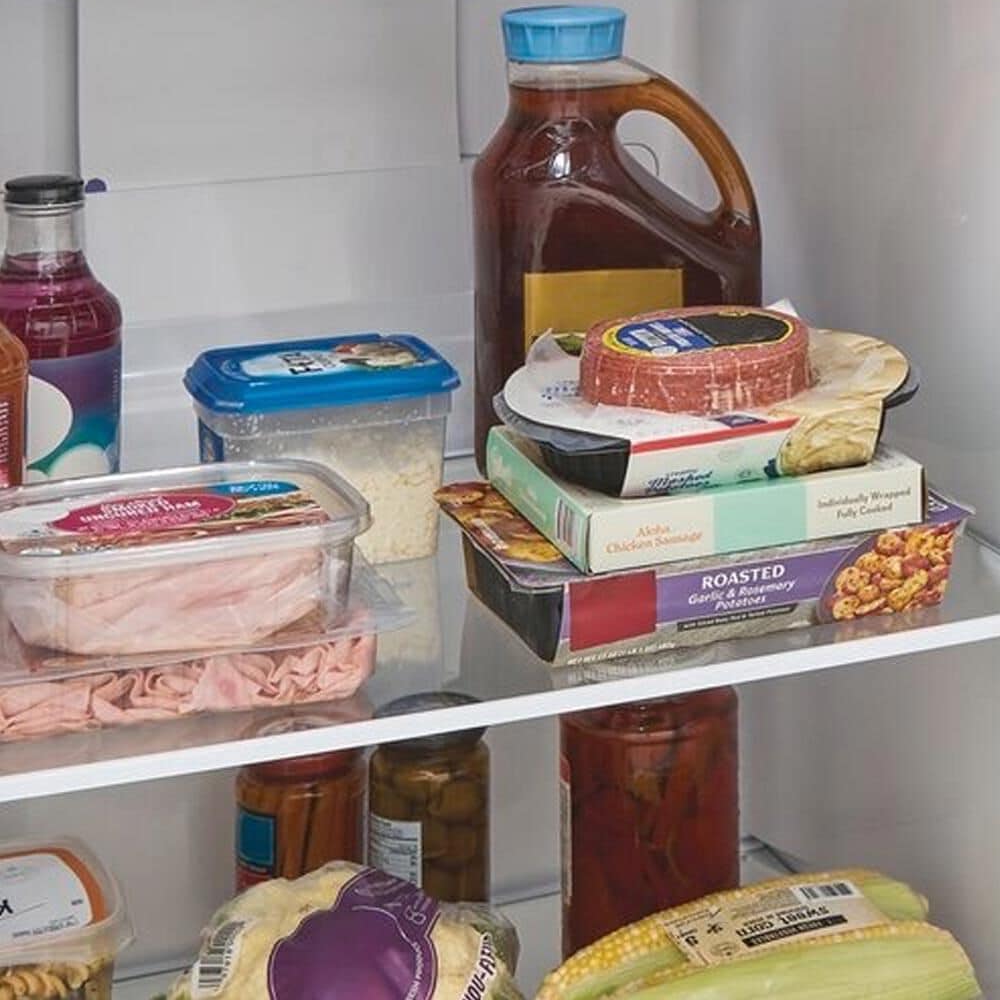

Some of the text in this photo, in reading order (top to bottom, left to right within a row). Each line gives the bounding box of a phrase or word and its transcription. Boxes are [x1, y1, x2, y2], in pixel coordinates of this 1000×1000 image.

[818, 487, 911, 509] Individually Wrapped
[836, 502, 893, 520] Fully Cooked
[606, 538, 653, 554] Chicken
[702, 564, 786, 590] ROASTED
[688, 577, 799, 606] Garlic & Rosemary
[714, 594, 768, 612] Potatoes
